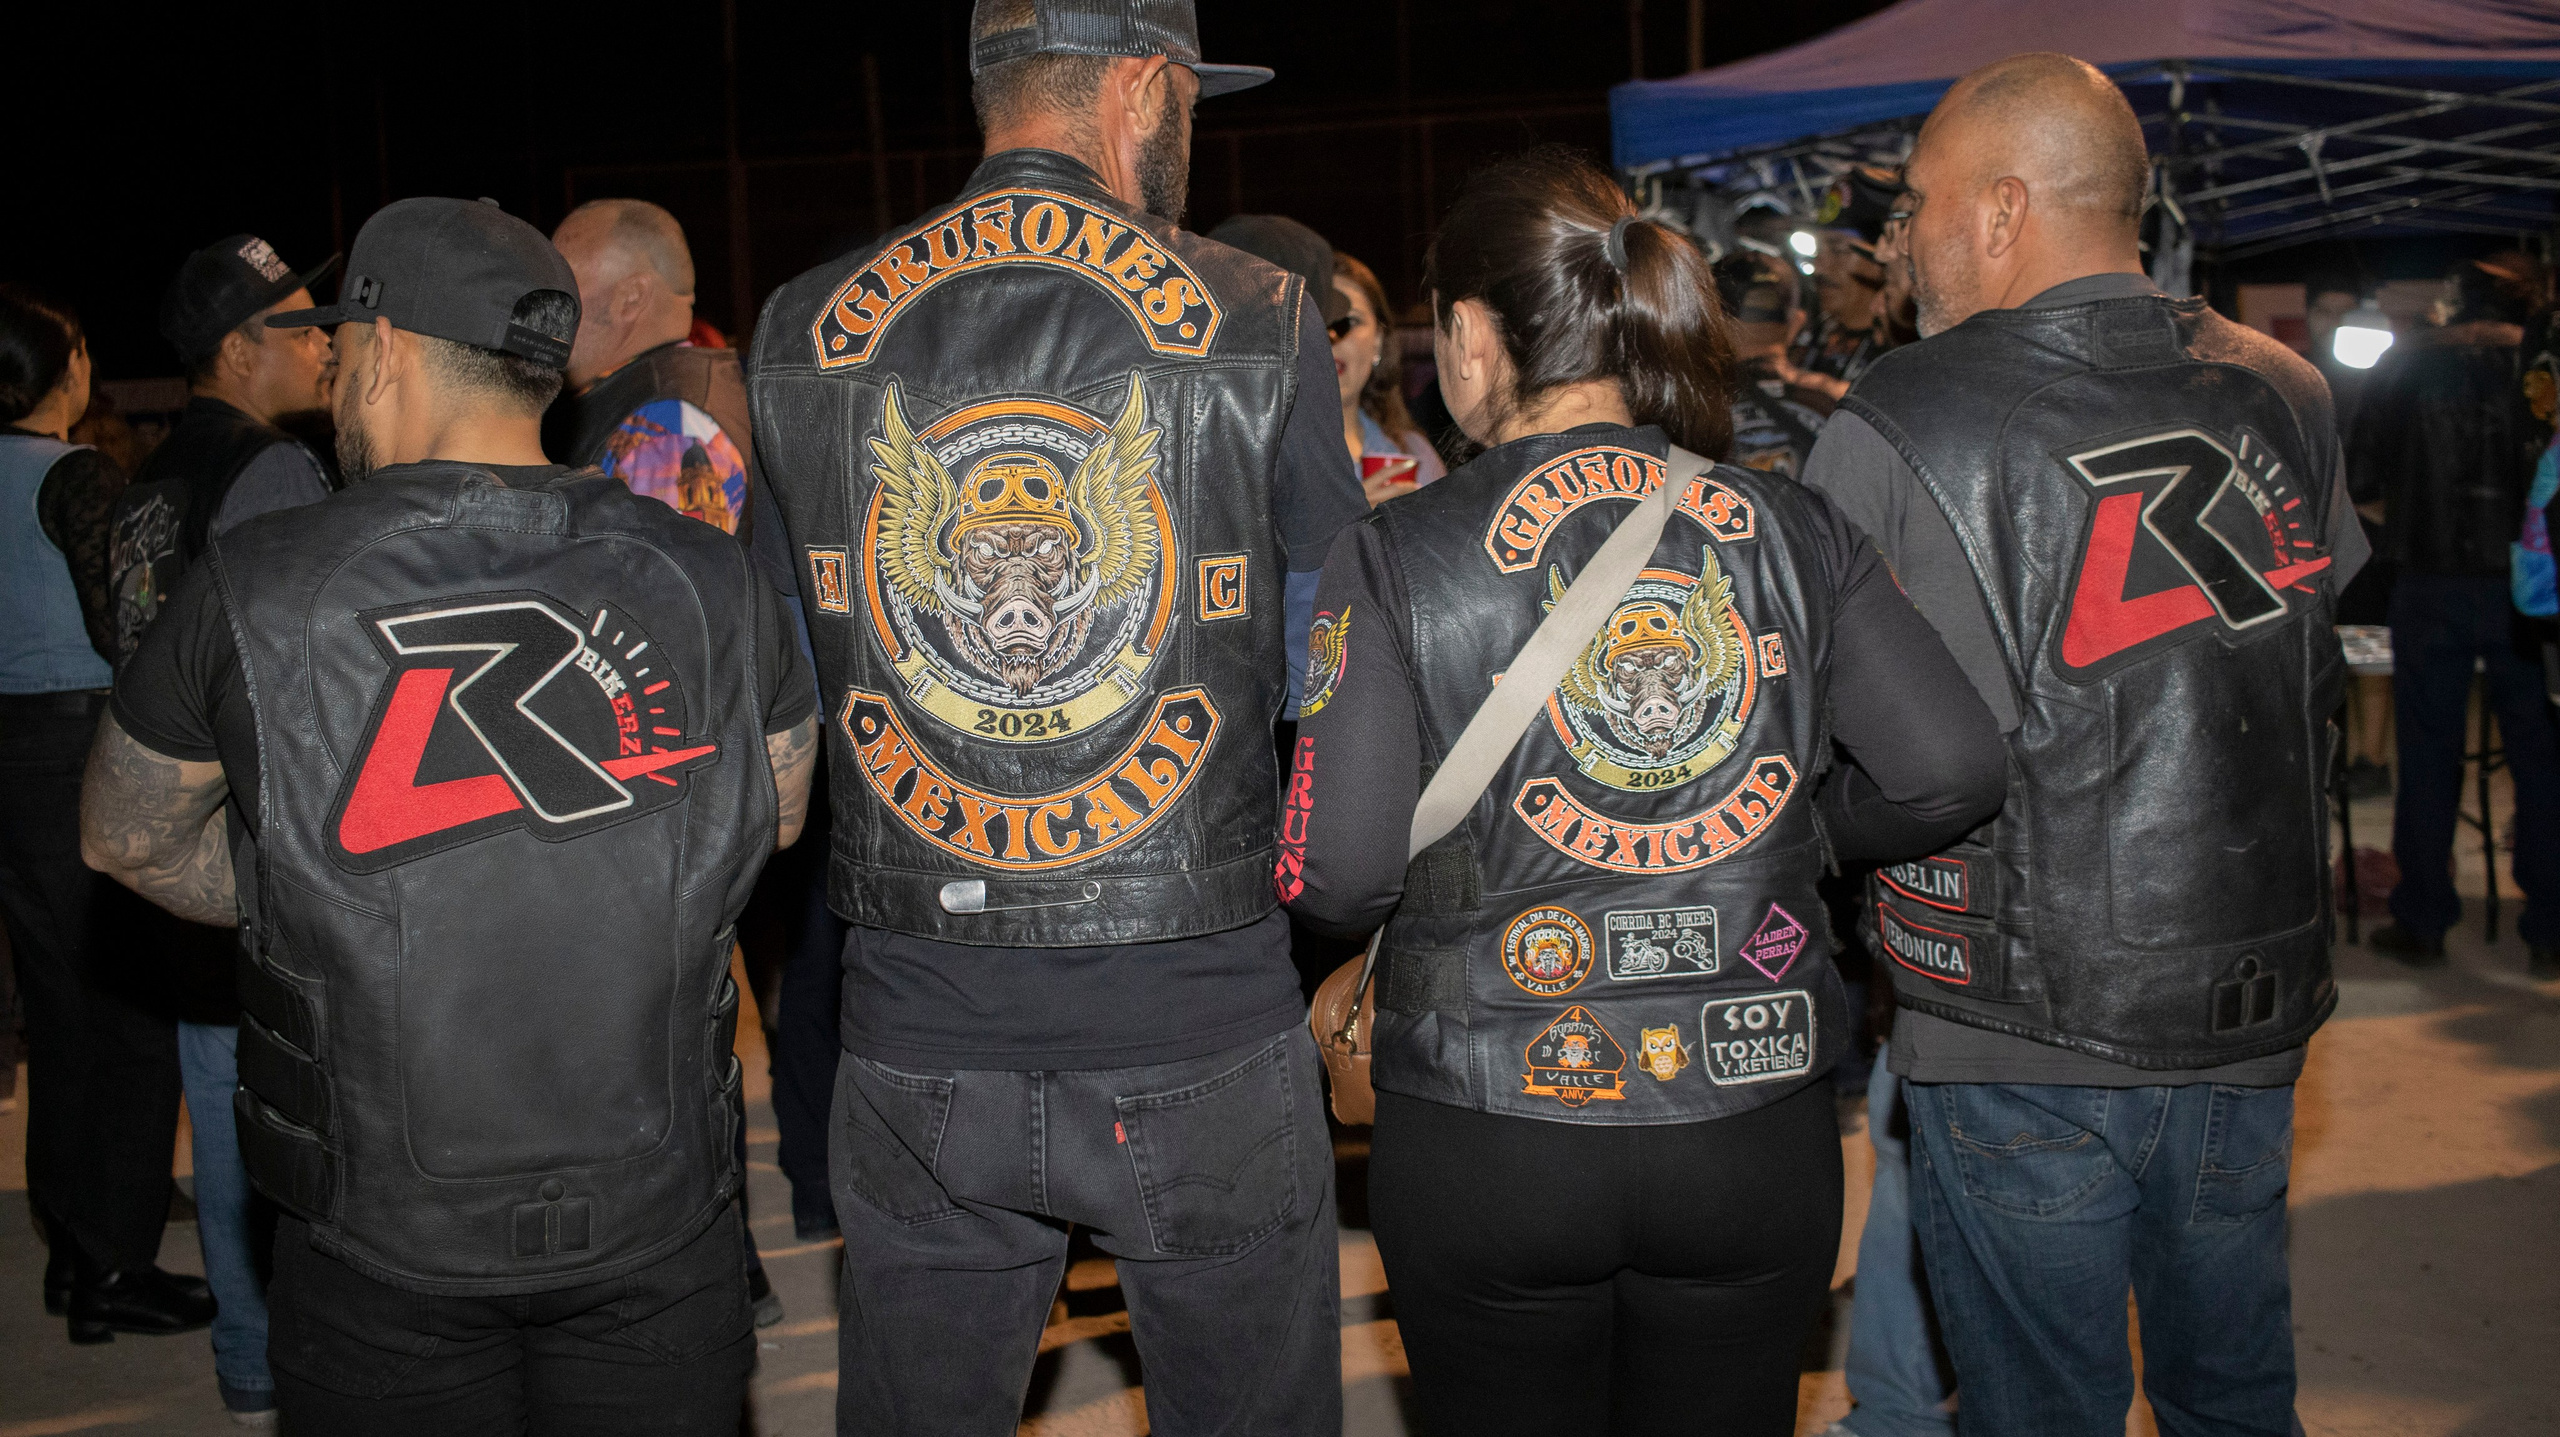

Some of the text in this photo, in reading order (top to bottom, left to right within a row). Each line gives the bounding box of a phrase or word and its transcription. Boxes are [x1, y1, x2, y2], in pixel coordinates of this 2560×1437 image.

[833, 199, 1204, 335] GRUÑONES
[1212, 564, 1239, 610] C
[1766, 637, 1783, 671] C
[575, 645, 642, 756] BIKERZ
[973, 709, 1071, 738] 2024
[859, 716, 1202, 860] MEXICALI
[1626, 765, 1692, 788] 2024
[1531, 774, 1782, 867] MEXICALI
[1506, 918, 1531, 953] FESTIVAL
[1529, 911, 1545, 921] DIA
[1547, 910, 1559, 920] DE
[1560, 914, 1577, 928] LAS
[1574, 926, 1591, 960] MADRES
[1610, 911, 1713, 931] CORRIDA BC BIKERS
[1651, 929, 1678, 940] 2024
[1755, 925, 1797, 947] LADREN
[1884, 915, 1965, 973] VERONICA
[1755, 941, 1797, 962] PERRAS
[1515, 972, 1525, 980] 20
[1527, 980, 1567, 993] VALLE
[1570, 1008, 1581, 1022] 4
[1723, 1000, 1792, 1031] SOY
[1710, 1033, 1807, 1062] TOXICA
[1546, 1071, 1604, 1087] VALLE
[1561, 1089, 1587, 1100] ANIV.
